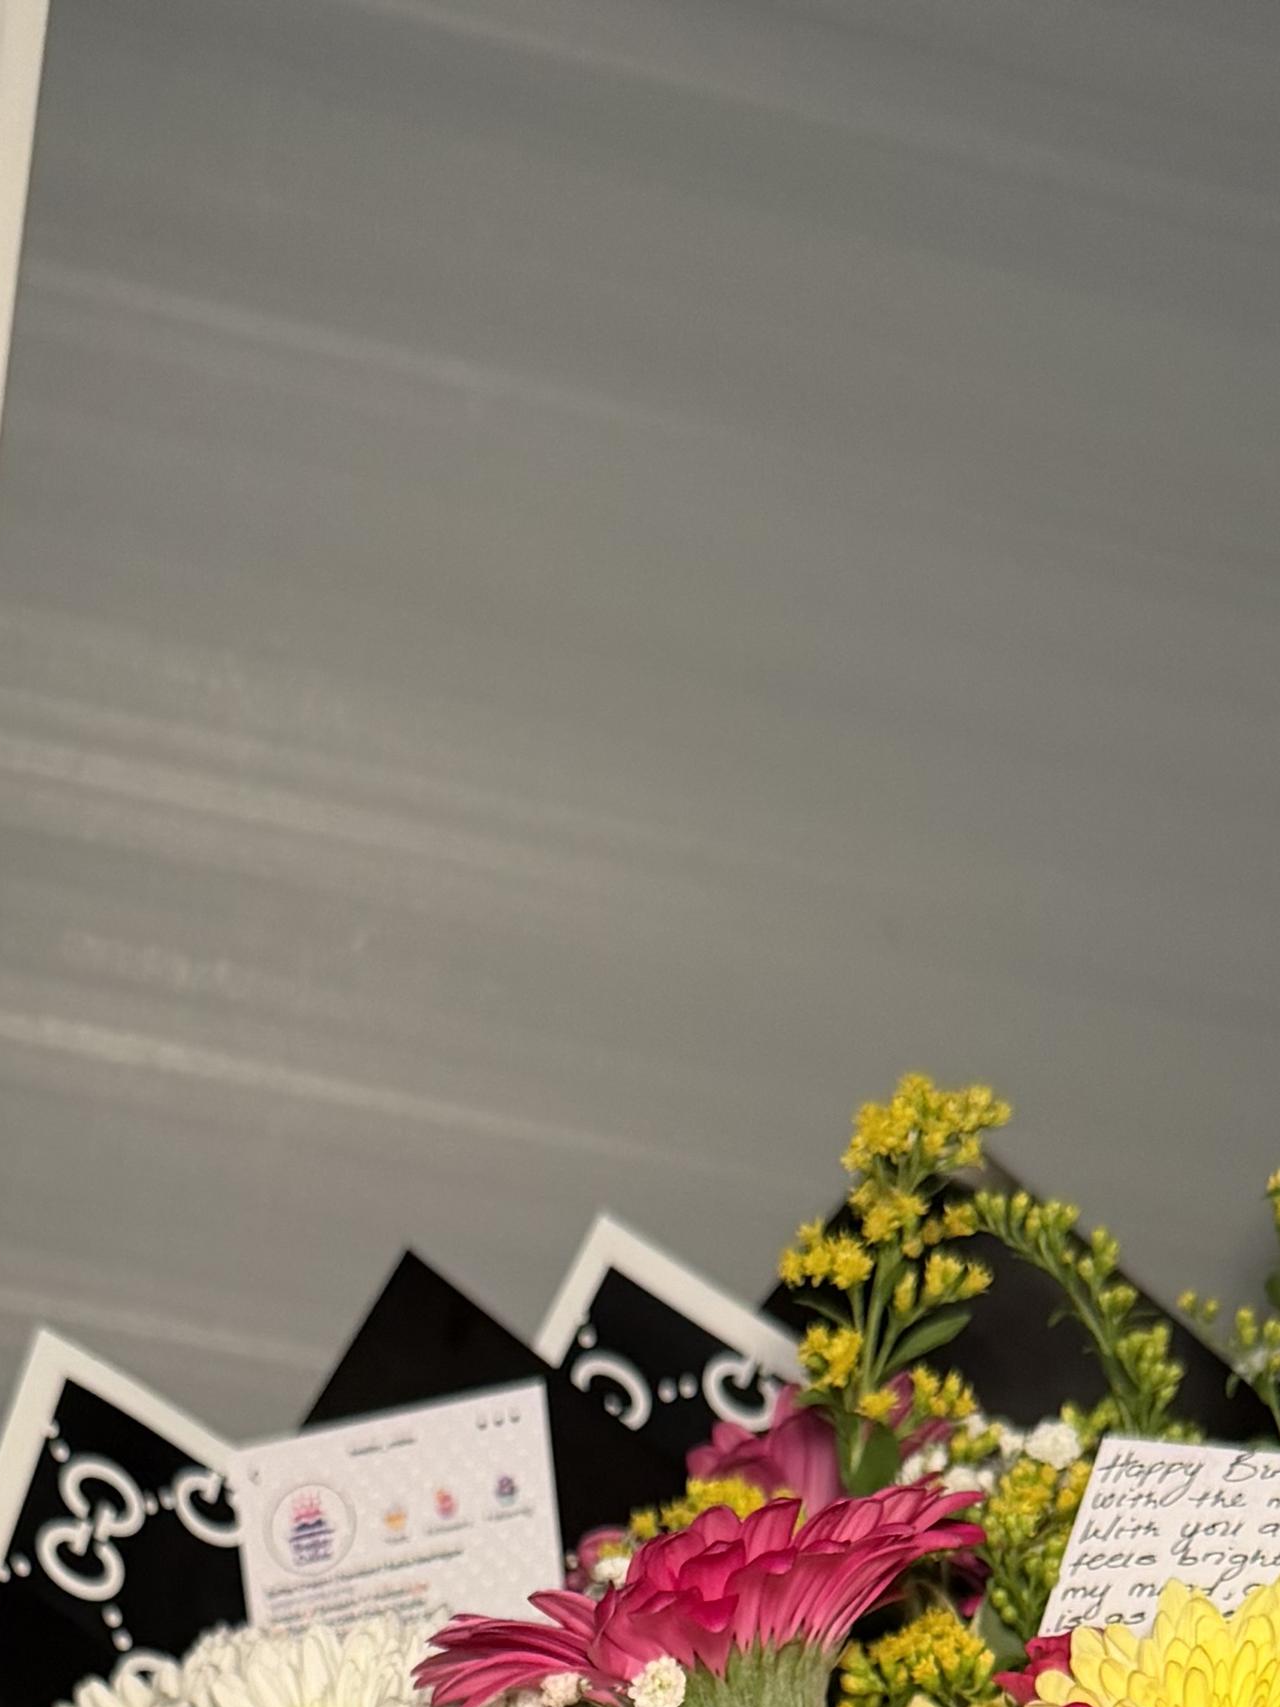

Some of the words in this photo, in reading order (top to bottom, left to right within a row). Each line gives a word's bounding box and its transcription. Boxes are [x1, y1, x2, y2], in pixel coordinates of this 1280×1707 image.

[1097, 1449, 1205, 1508] Happy
[1091, 1487, 1158, 1510] with
[1188, 1488, 1248, 1509] the
[1078, 1514, 1160, 1544] With
[1171, 1520, 1245, 1556] you
[1070, 1550, 1157, 1577] feels
[1061, 1584, 1112, 1620] my
[1104, 1611, 1146, 1626] as
